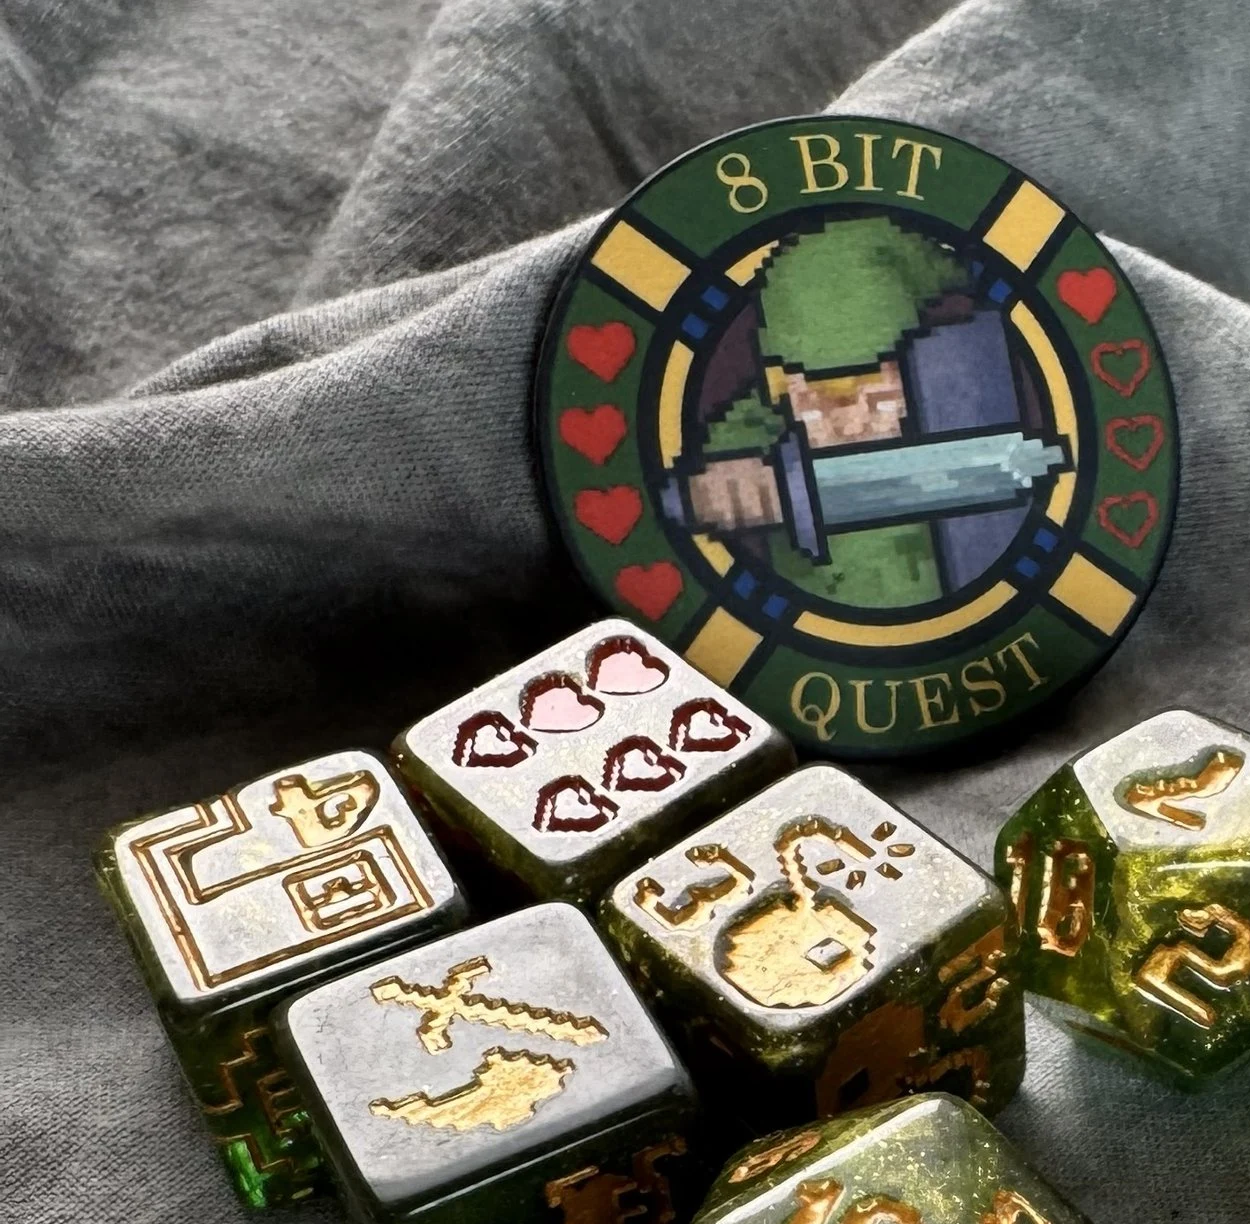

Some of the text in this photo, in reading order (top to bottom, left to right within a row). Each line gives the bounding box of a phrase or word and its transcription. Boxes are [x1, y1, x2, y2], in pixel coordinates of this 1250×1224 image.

[716, 132, 942, 214] 8 BIT
[790, 632, 1048, 741] QUEST
[634, 842, 757, 932] 3
